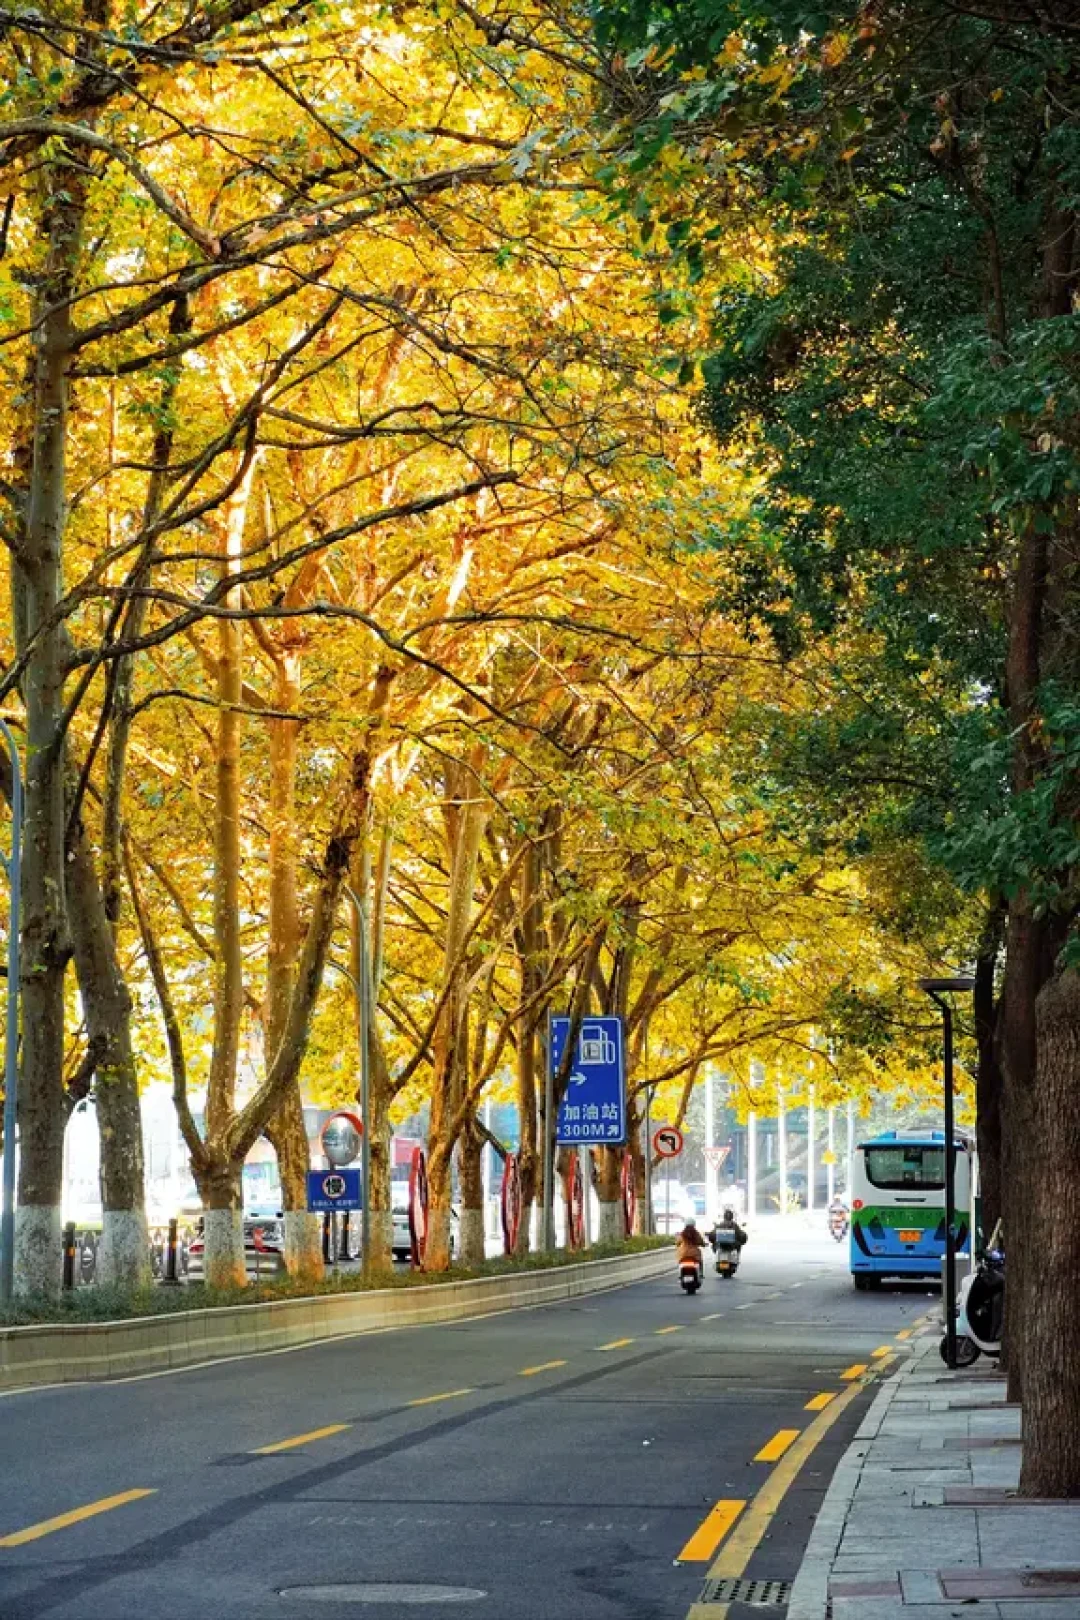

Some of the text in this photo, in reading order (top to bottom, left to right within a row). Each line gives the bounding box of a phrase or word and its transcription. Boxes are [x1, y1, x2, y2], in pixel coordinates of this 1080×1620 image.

[564, 1102, 618, 1121] 加油站
[564, 1123, 604, 1137] 300M
